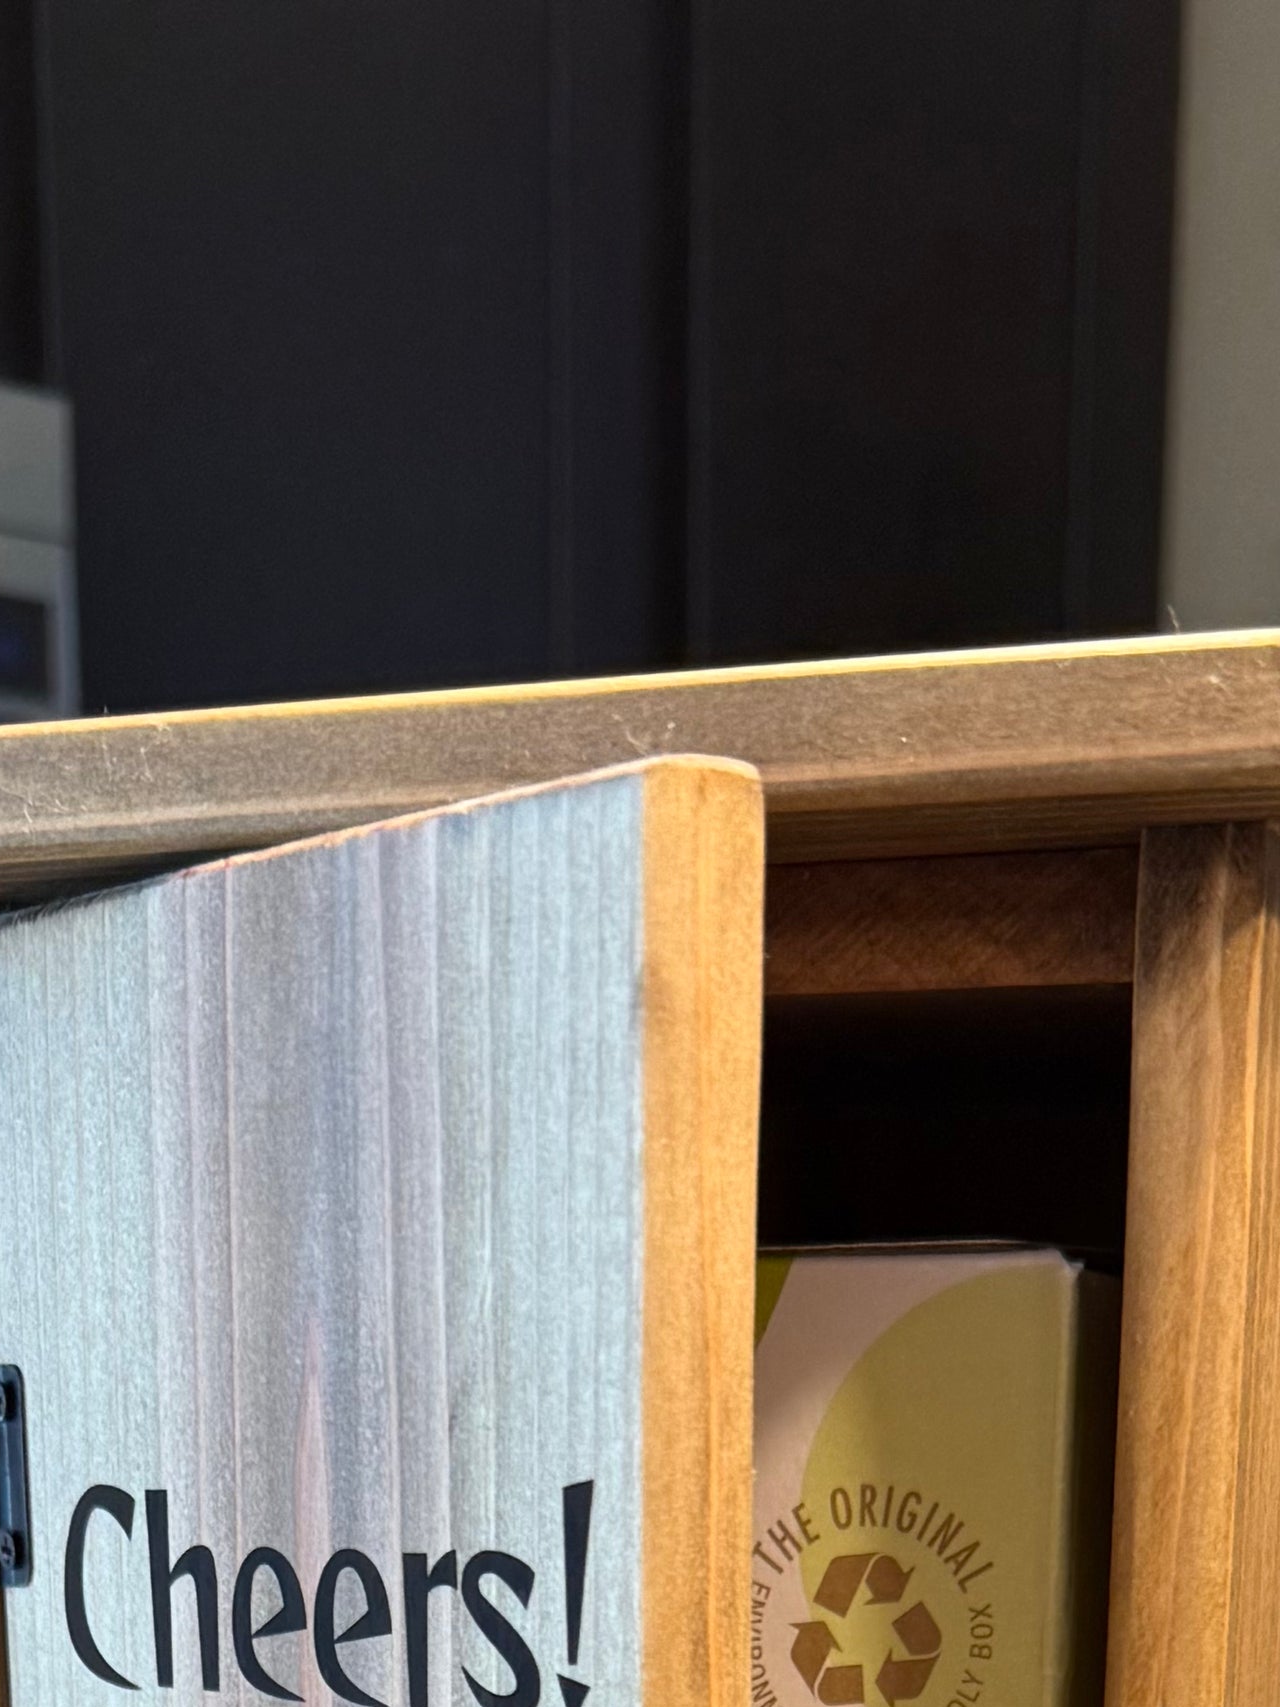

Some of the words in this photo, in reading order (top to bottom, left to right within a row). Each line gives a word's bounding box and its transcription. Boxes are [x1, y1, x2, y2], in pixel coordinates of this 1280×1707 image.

[752, 1502, 822, 1576] THE
[830, 1484, 996, 1594] ORIGINAL
[968, 1602, 994, 1661] BOX
